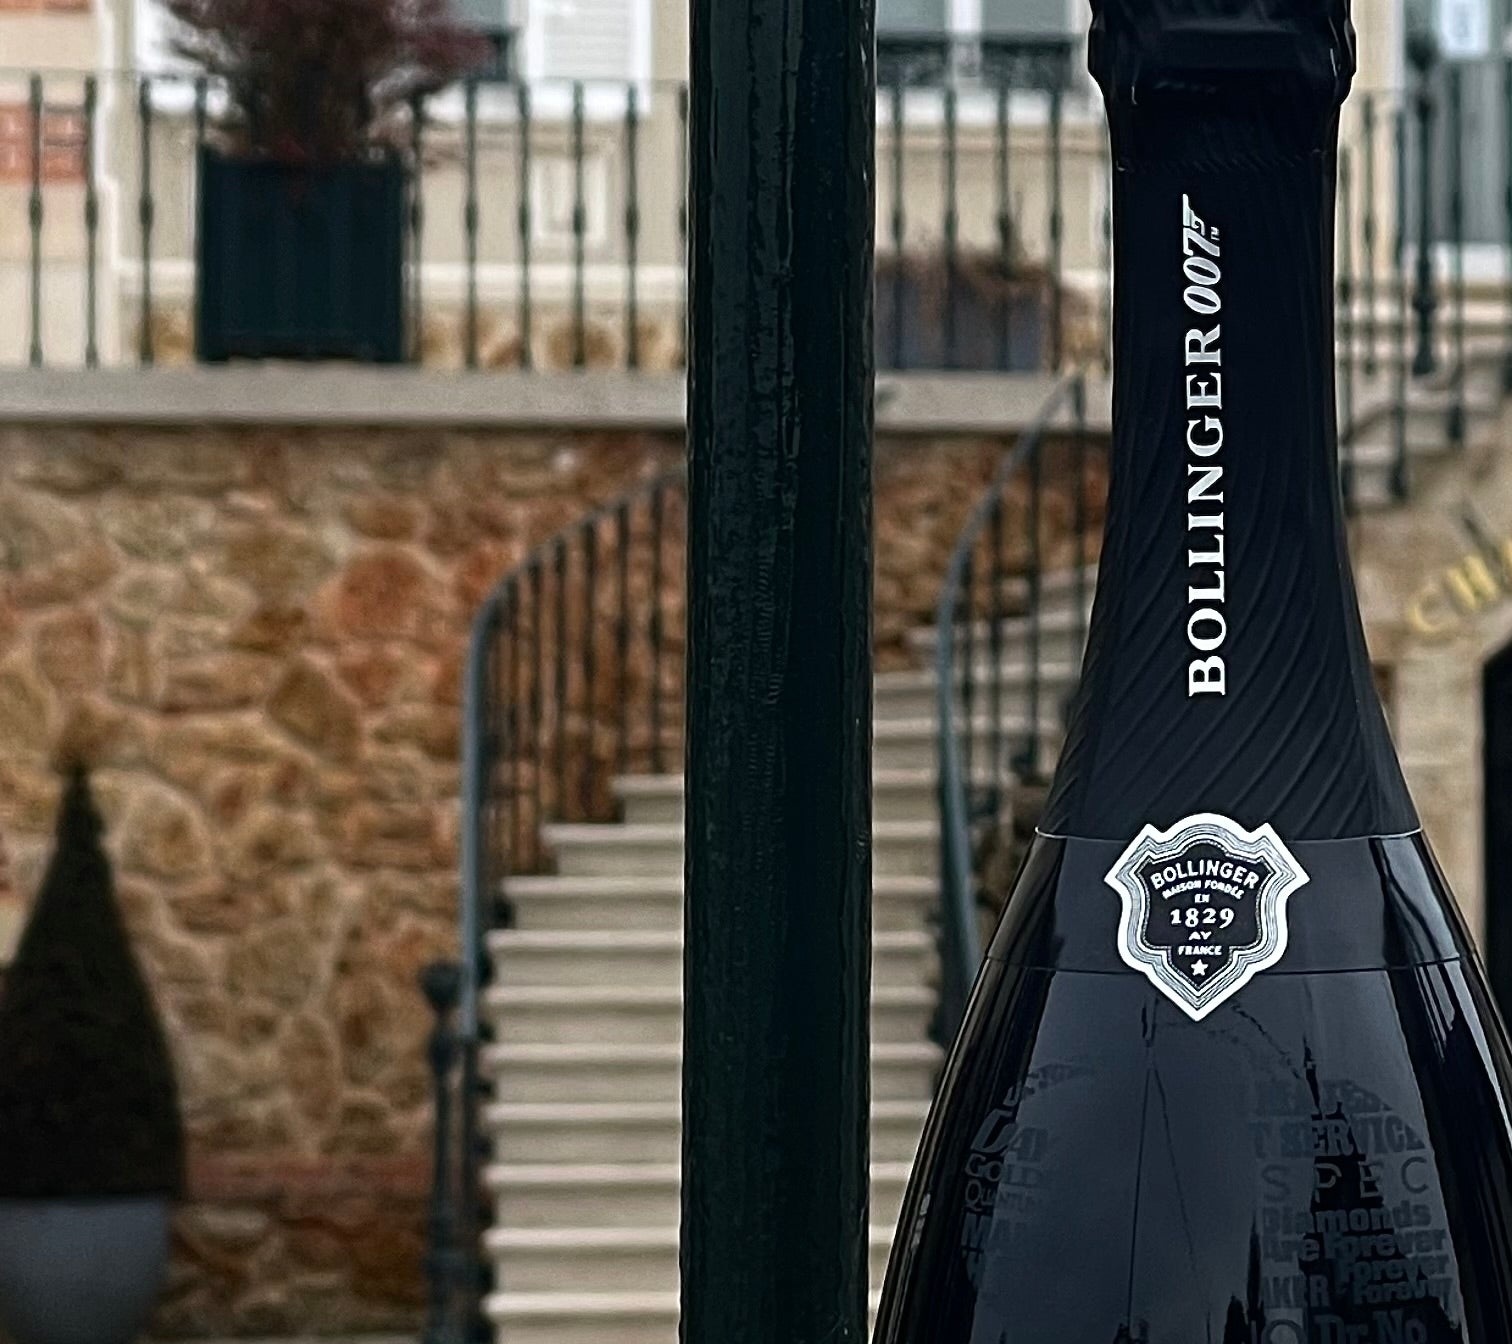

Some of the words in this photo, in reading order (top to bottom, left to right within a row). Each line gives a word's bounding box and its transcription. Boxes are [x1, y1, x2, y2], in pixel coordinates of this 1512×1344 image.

[1185, 323, 1227, 698] BOLLINGER
[1151, 859, 1259, 889] BOLLINGER
[1162, 880, 1201, 899] MAISON
[1194, 893, 1210, 903] EN
[1170, 907, 1235, 929] 1829
[1178, 945, 1222, 956] FRANCE
